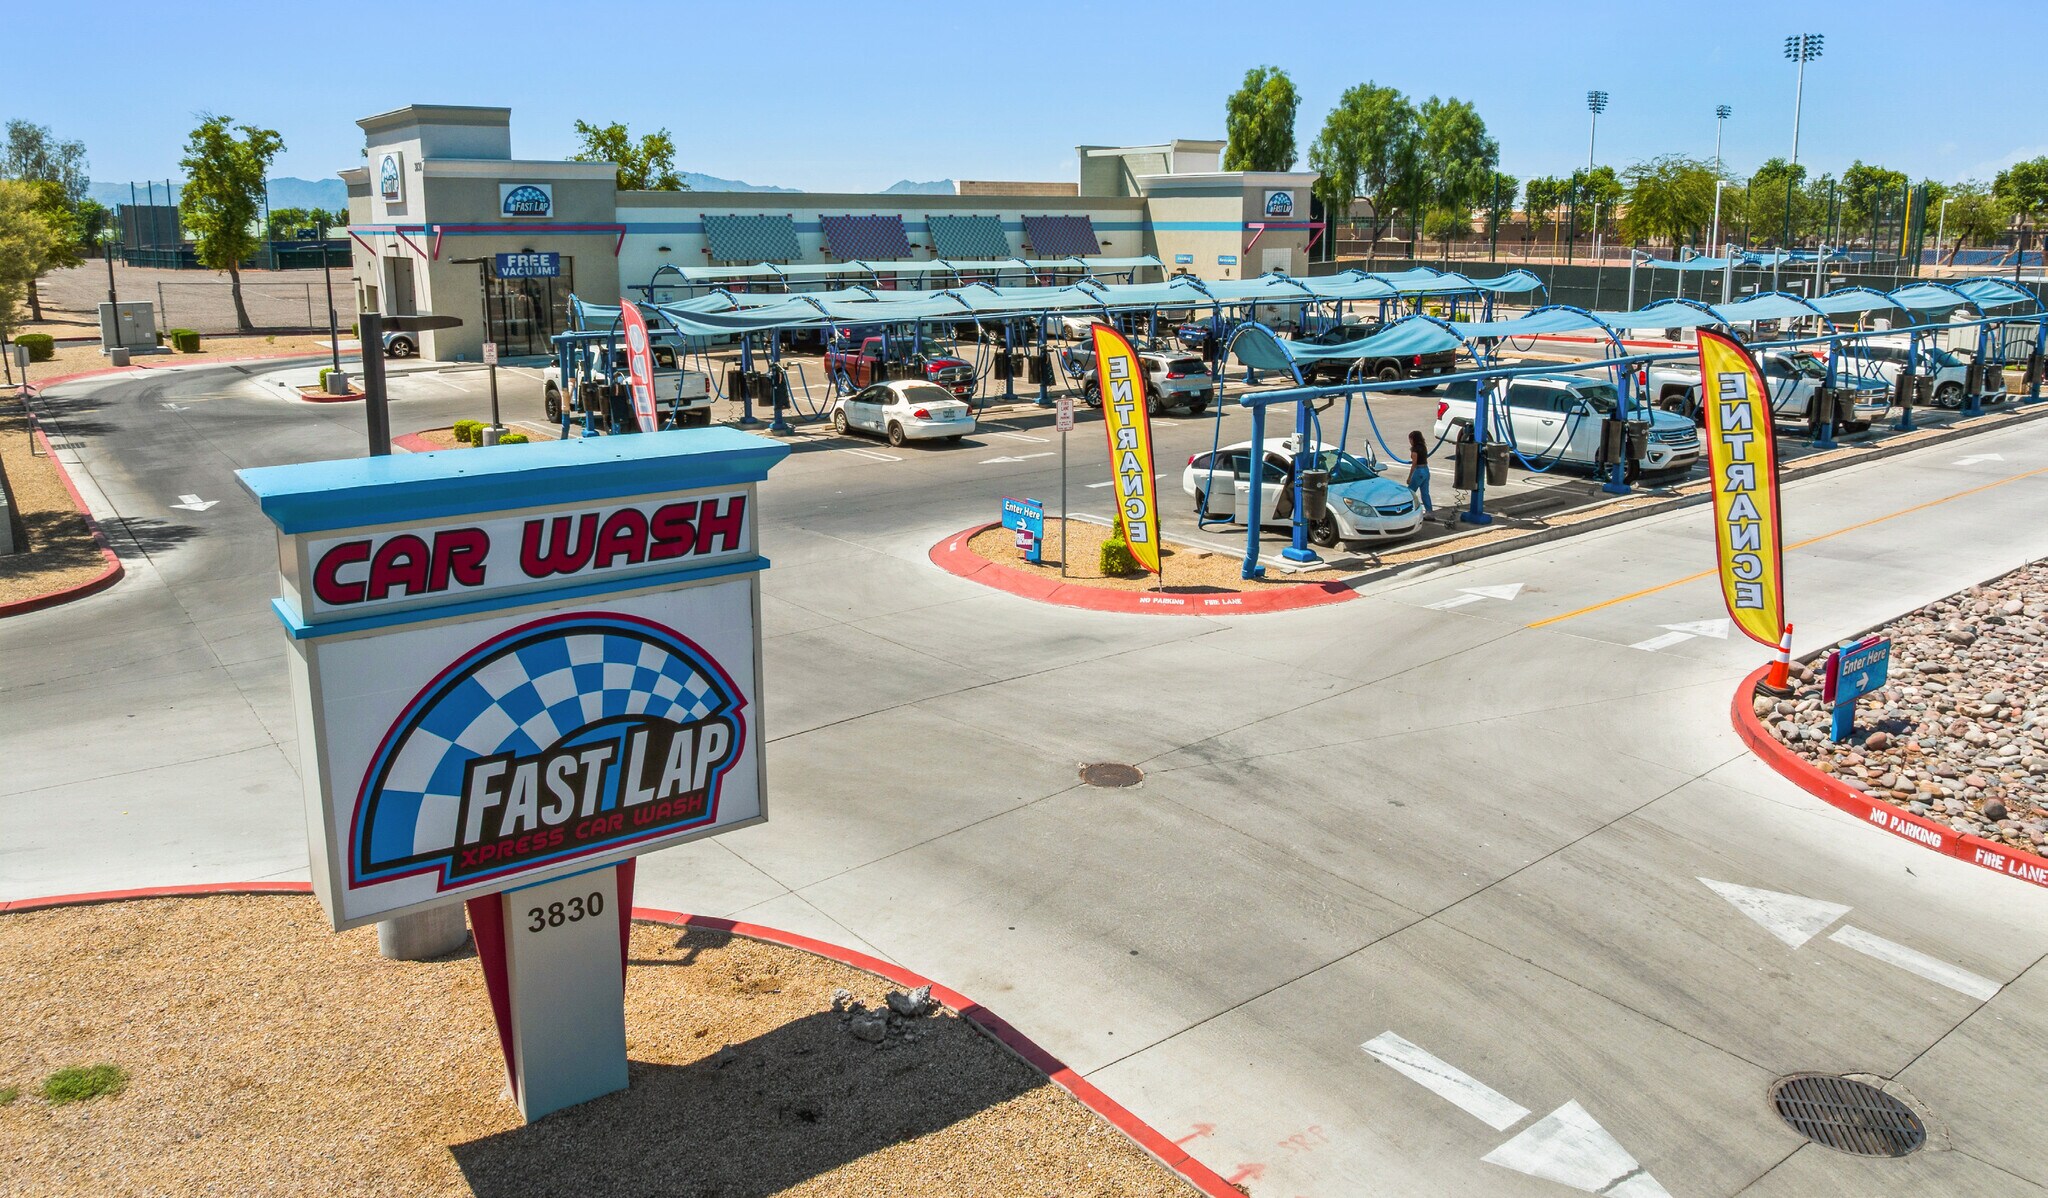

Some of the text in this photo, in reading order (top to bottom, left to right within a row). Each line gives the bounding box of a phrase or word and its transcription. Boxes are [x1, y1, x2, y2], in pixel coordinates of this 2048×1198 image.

[515, 202, 549, 212] FAST LAP
[1273, 204, 1284, 213] FAST
[502, 266, 556, 276] VACUUM!
[507, 254, 550, 267] FREE
[1005, 501, 1041, 520] Enter Here
[313, 495, 747, 606] CAR WASH
[1152, 597, 1185, 605] PARKING
[1842, 648, 1887, 676] Enter Here
[463, 722, 728, 845] FAST LAP
[460, 794, 704, 869] XPRESS CAR WASH
[1869, 807, 2048, 885] NO PARKING FIRE LANE
[528, 891, 605, 934] 3830
